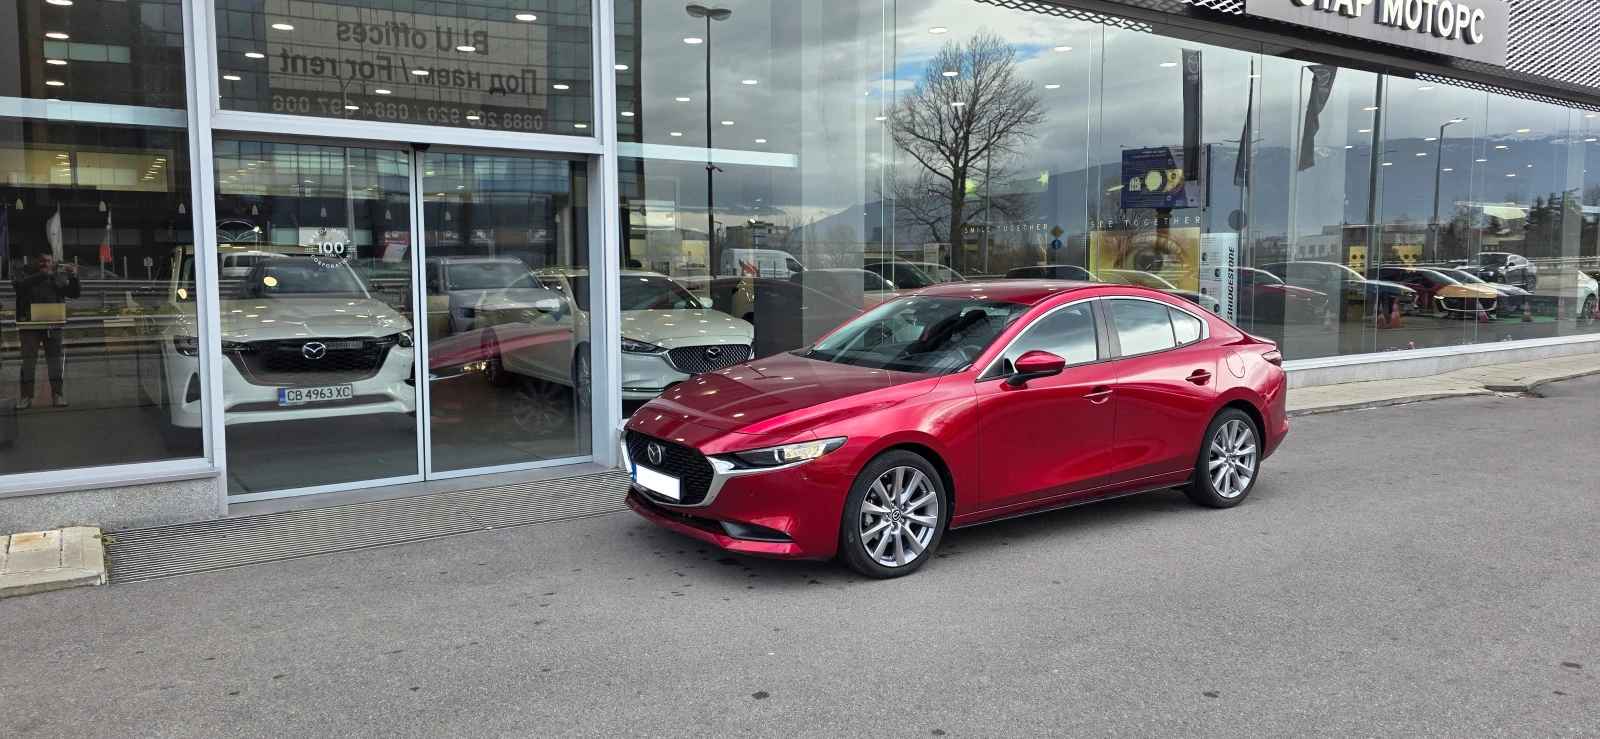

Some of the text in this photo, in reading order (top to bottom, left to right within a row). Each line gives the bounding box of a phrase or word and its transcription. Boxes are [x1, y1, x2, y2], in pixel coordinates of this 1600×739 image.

[1375, 0, 1485, 44] МОТОРС
[964, 223, 1048, 234] SMILE TOGETHER
[1090, 216, 1201, 228] SEE TOGETHER
[331, 227, 351, 245] MOTOR
[316, 241, 345, 254] 100
[310, 254, 351, 269] CORPORATION
[1227, 245, 1235, 321] BRIDGESTONE
[287, 390, 303, 402] CB
[305, 388, 333, 400] 4963
[335, 386, 351, 398] XC
